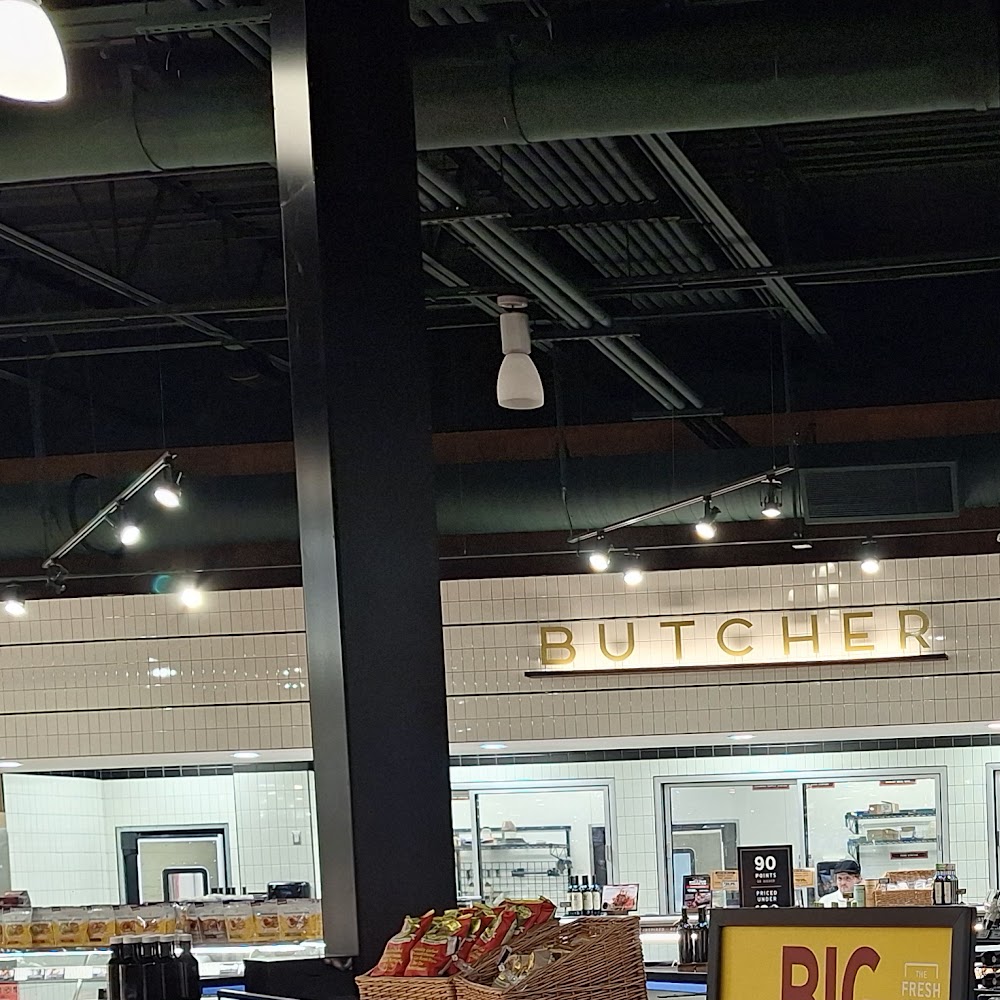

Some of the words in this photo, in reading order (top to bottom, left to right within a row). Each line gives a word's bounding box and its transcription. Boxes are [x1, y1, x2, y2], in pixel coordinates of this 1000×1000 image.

[539, 609, 932, 666] BUTCHER
[754, 855, 777, 871] 90
[915, 970, 928, 979] THE
[901, 981, 941, 998] FRESH
